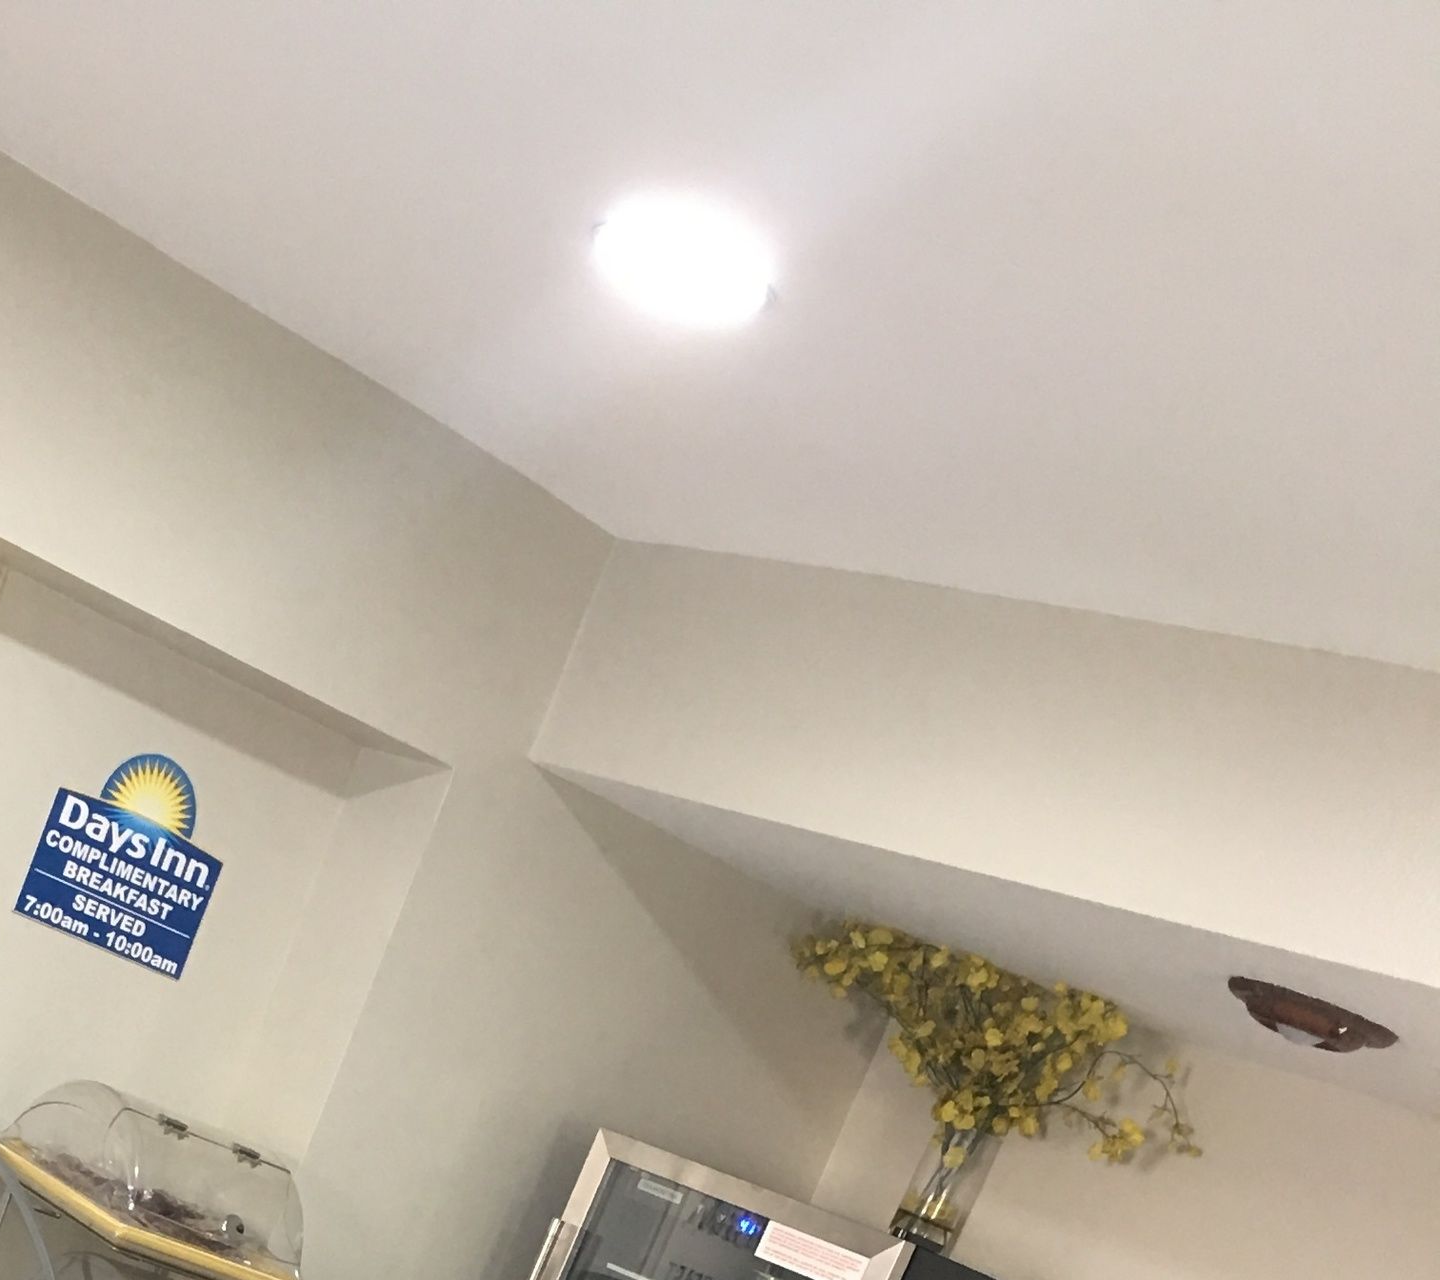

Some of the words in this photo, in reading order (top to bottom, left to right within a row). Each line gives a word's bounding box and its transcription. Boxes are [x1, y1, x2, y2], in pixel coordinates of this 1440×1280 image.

[45, 830, 204, 911] COMPLIMENTARY
[59, 795, 150, 859] Days
[150, 837, 209, 888] Inn
[63, 860, 173, 920] BREAKFAST
[72, 894, 146, 937] SERVED
[23, 895, 89, 937] 7:00am
[106, 932, 178, 975] 10:00am
